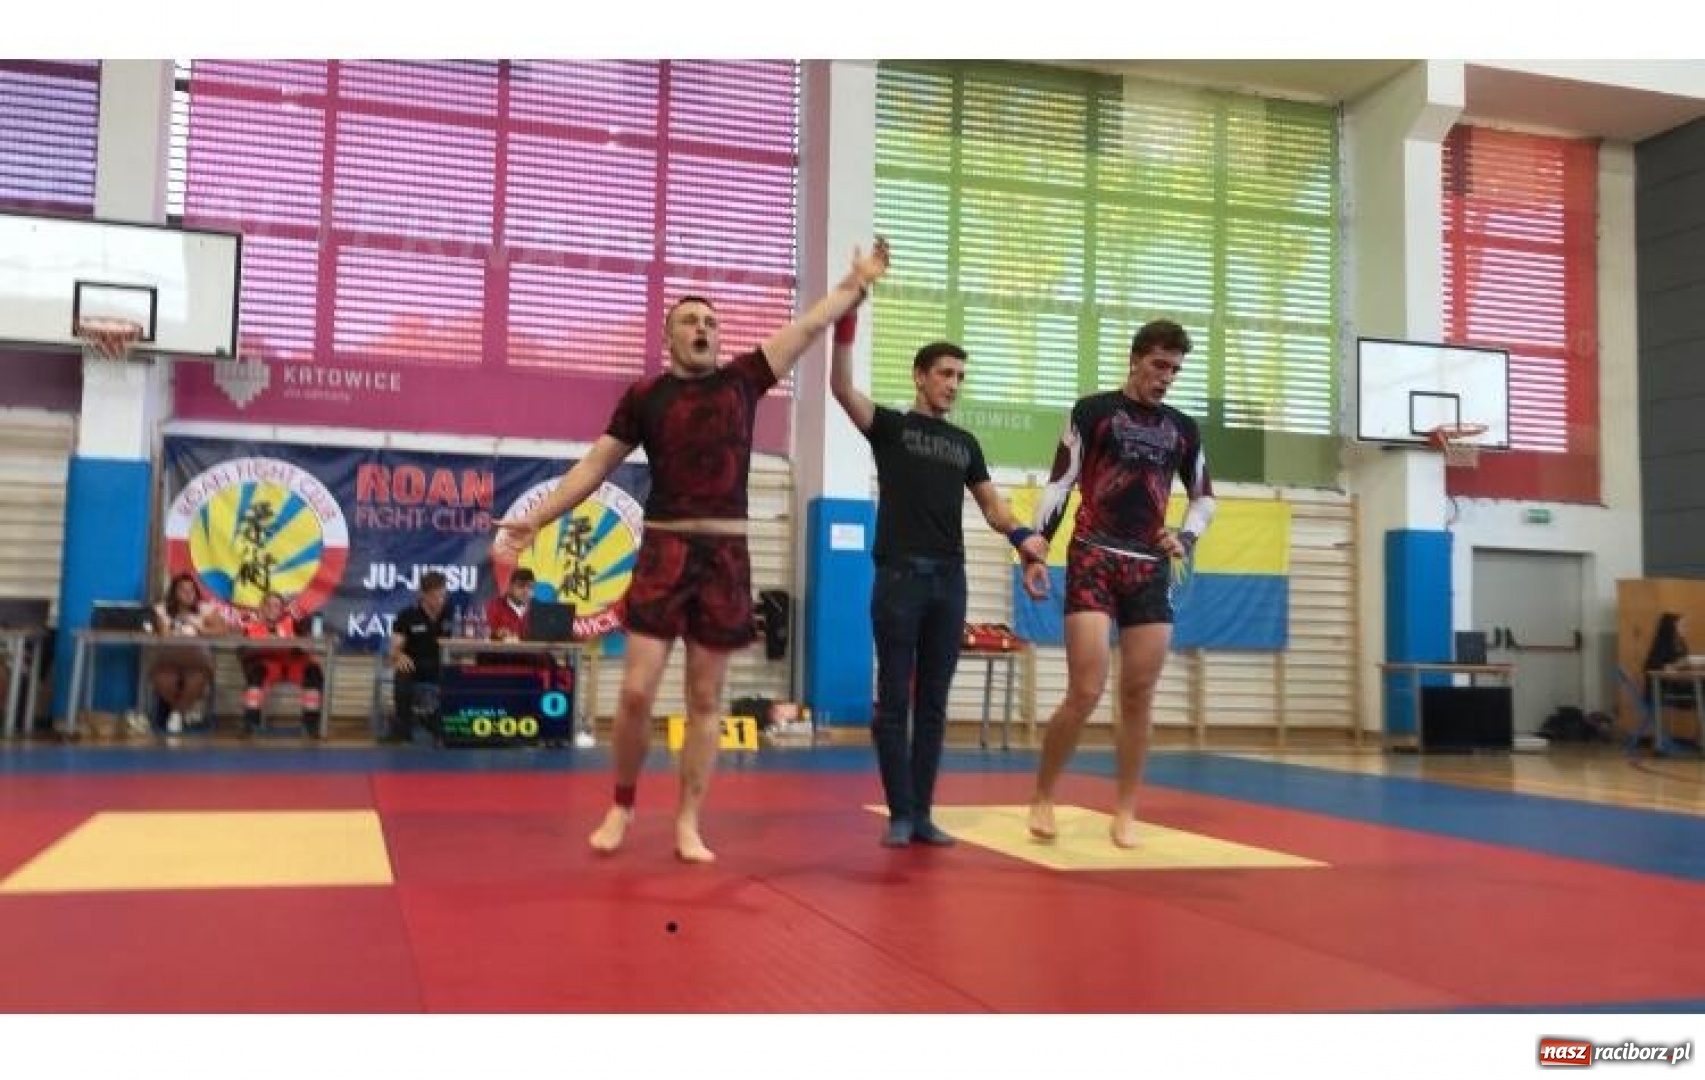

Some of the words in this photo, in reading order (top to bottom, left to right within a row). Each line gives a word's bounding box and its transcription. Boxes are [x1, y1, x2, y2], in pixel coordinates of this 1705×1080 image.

[283, 365, 401, 392] KATOWICE
[356, 463, 494, 509] ROAN
[355, 506, 424, 531] FIGHT
[431, 508, 492, 533] CLUB
[541, 691, 568, 717] 0
[473, 716, 539, 738] 0:00
